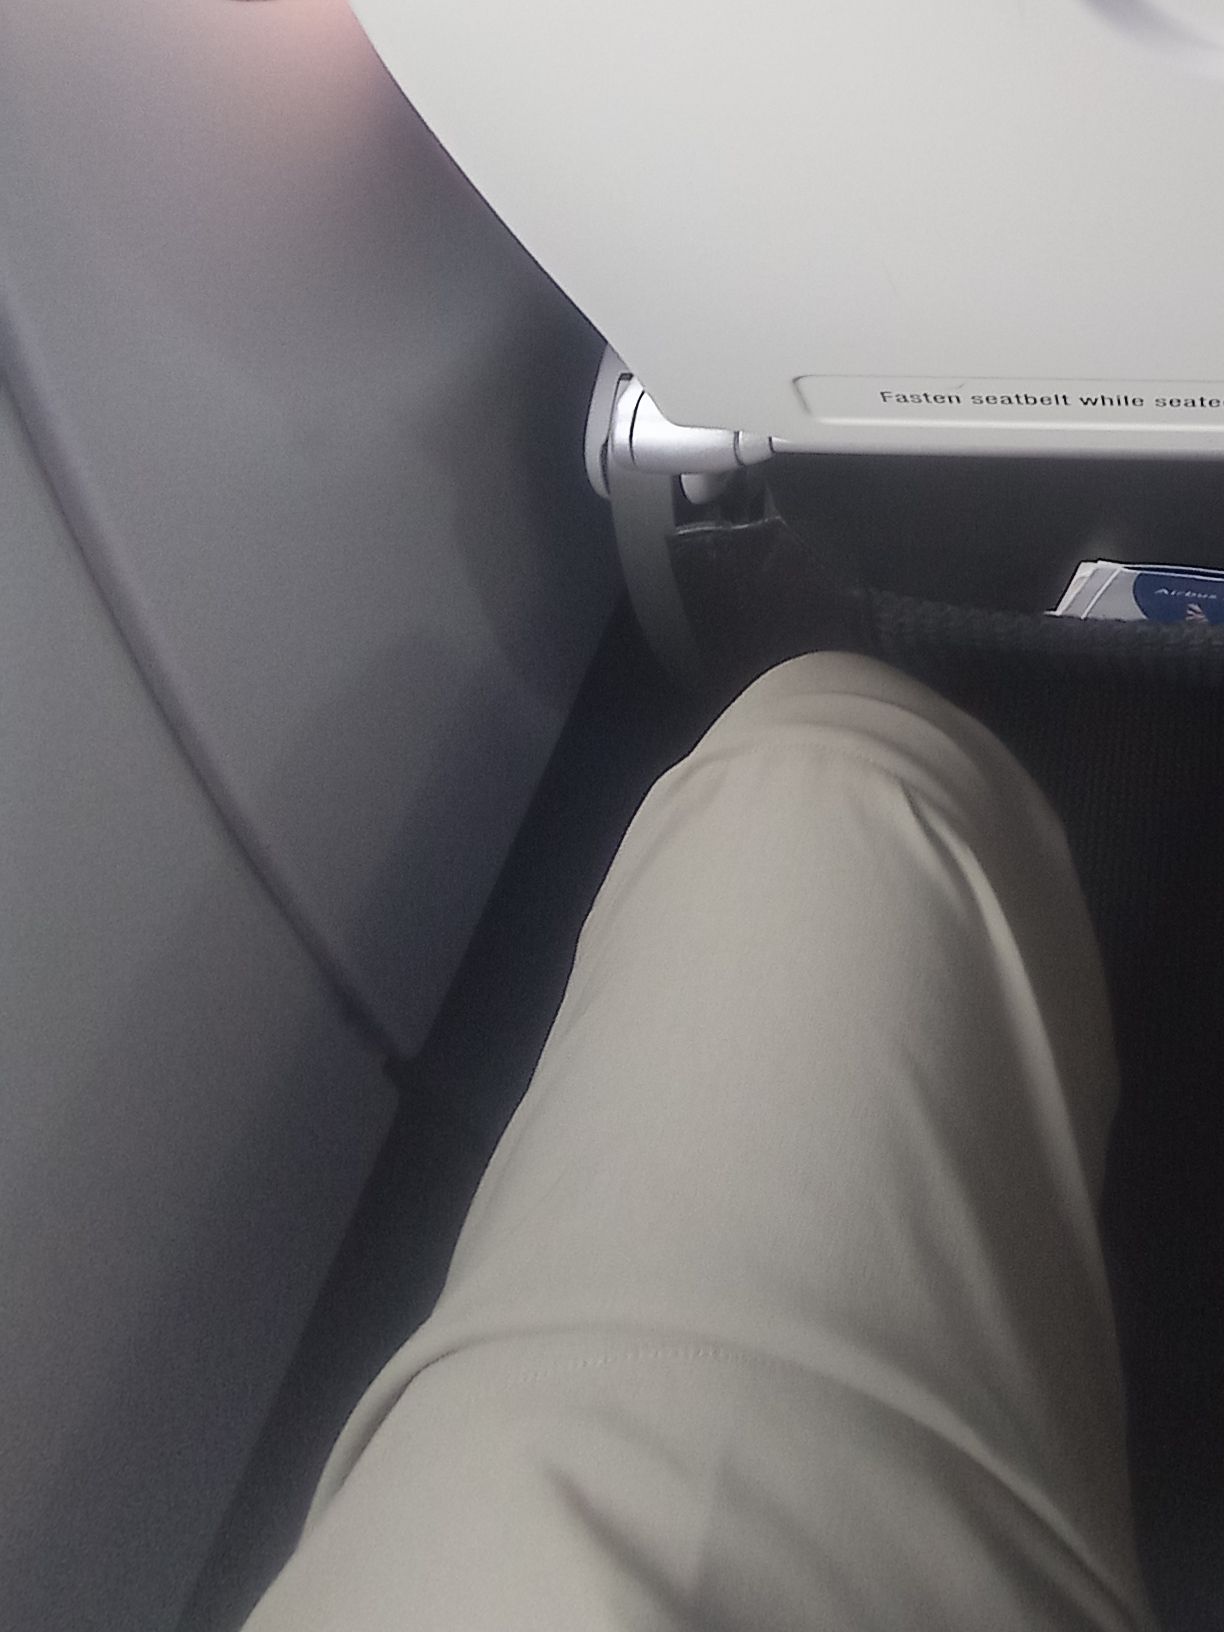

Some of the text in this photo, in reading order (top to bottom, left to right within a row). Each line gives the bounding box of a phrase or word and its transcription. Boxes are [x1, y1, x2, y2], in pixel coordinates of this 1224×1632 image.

[880, 390, 962, 405] Fasten
[971, 392, 1070, 407] seatbelt
[1079, 394, 1145, 408] while
